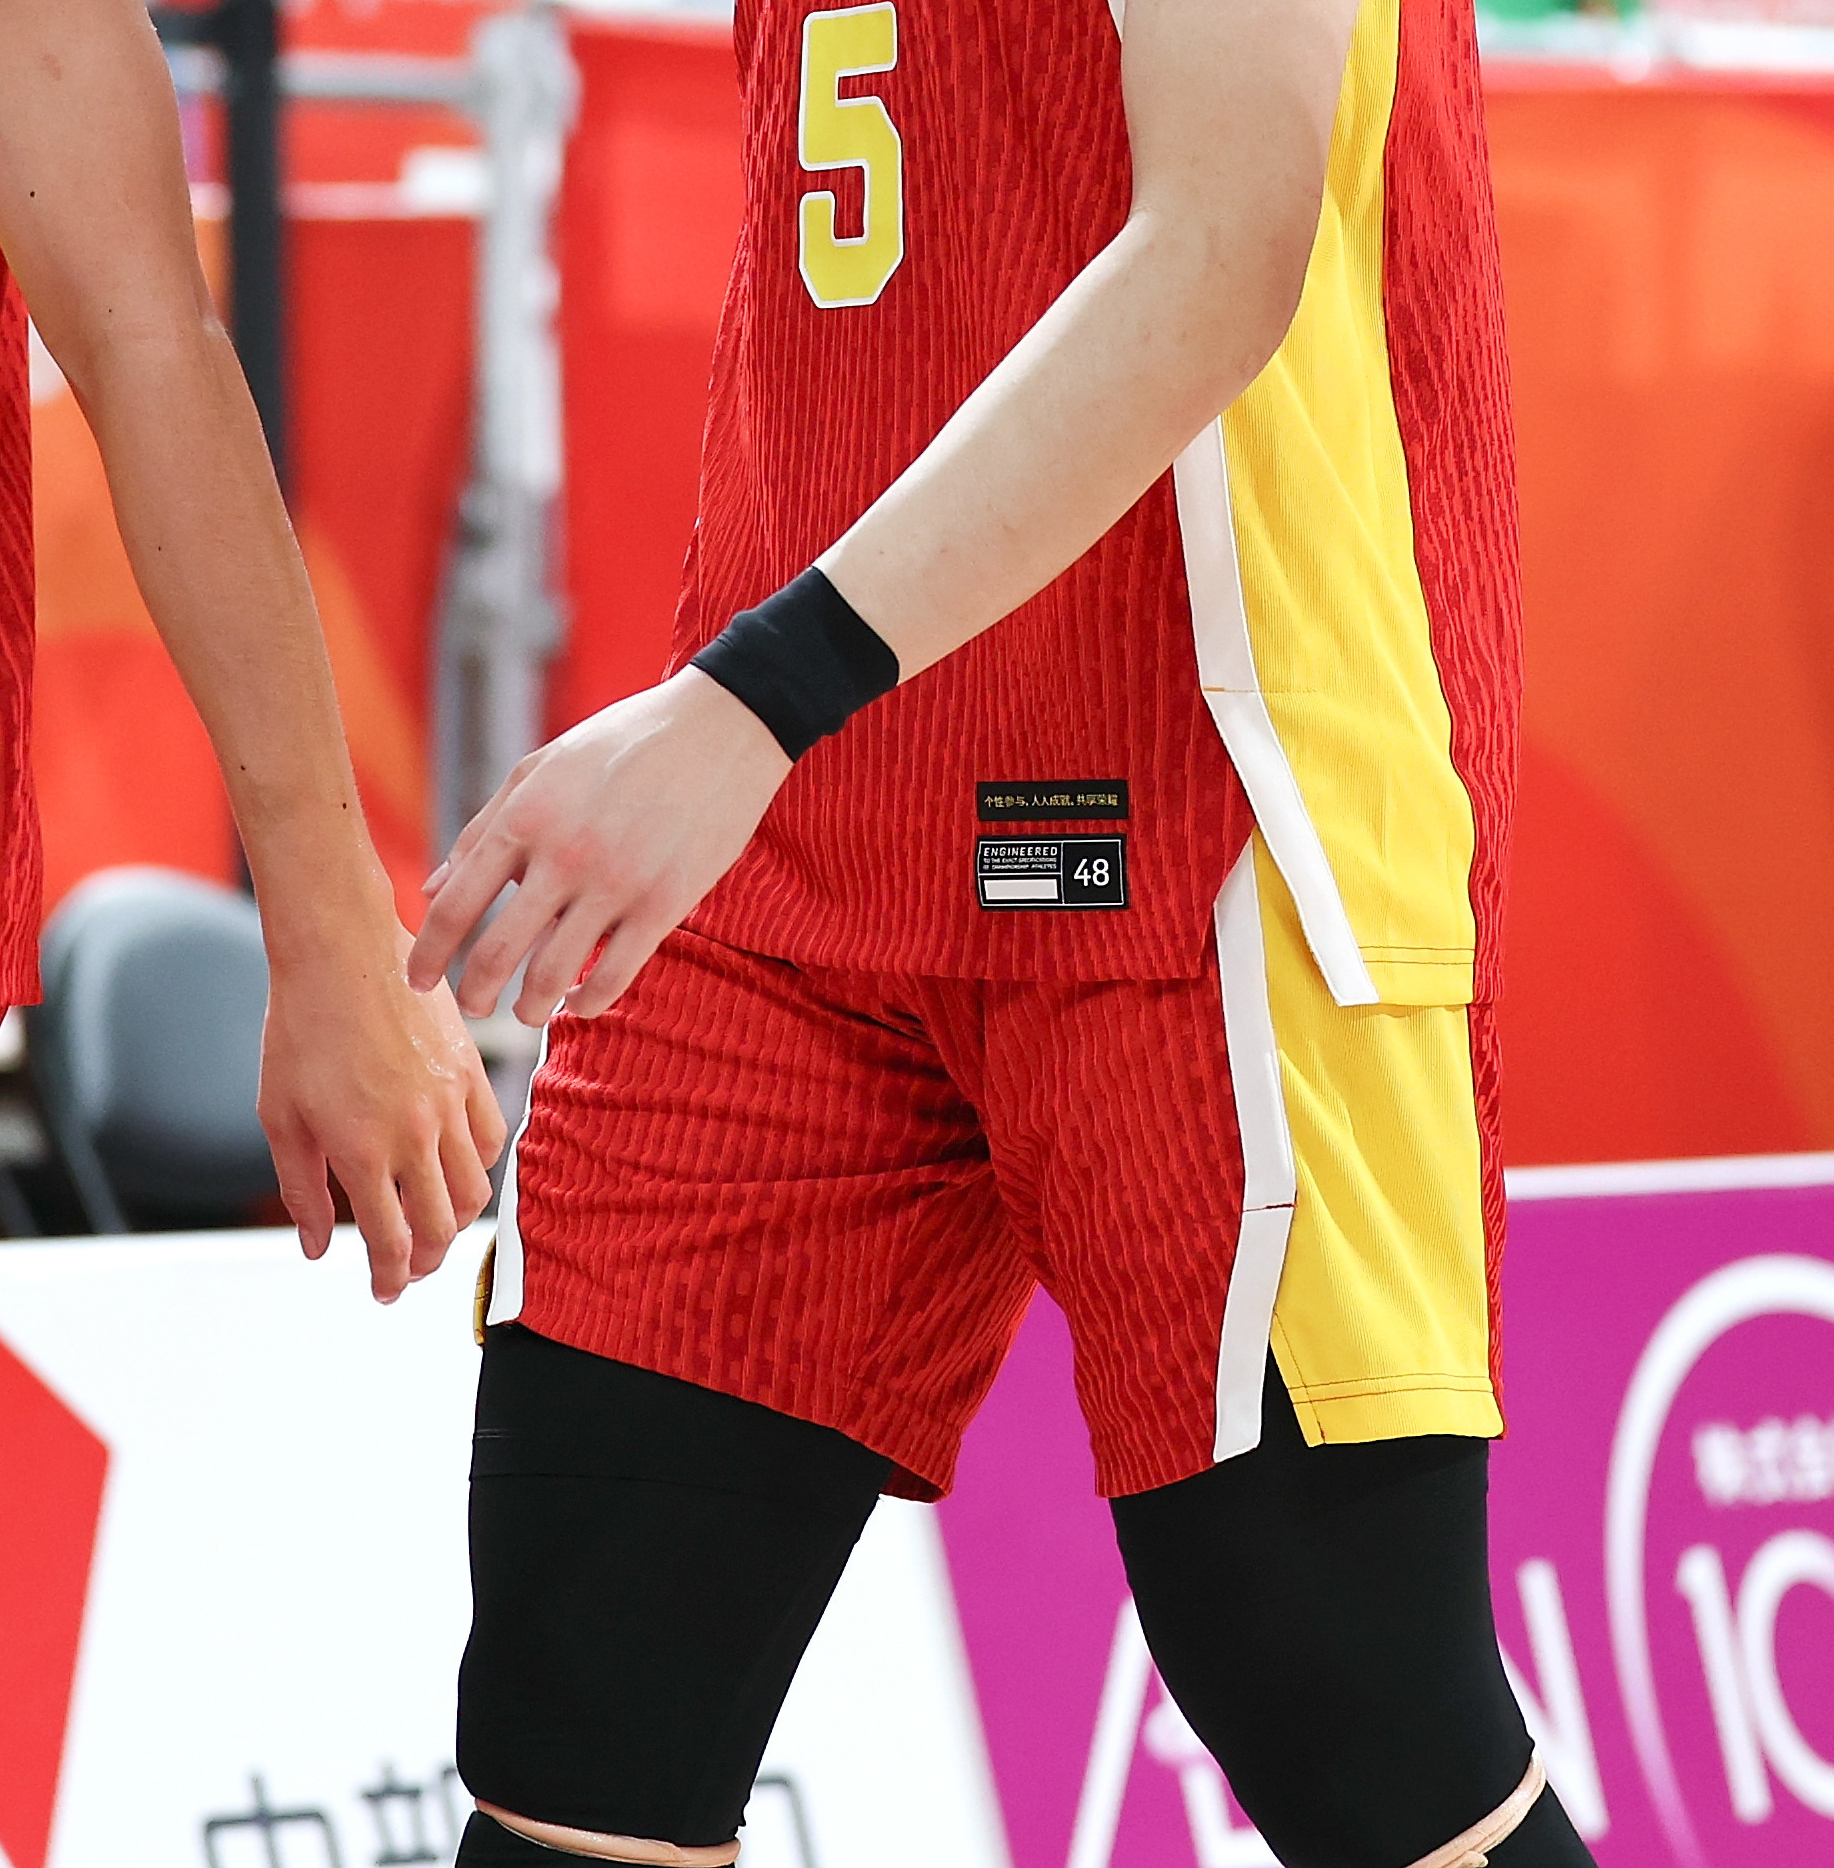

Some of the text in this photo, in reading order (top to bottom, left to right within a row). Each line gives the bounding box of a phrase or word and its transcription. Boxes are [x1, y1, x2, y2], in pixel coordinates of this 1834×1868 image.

[798, 0, 905, 309] 5
[983, 846, 1058, 857] ENGINEERED
[1073, 858, 1110, 886] 48
